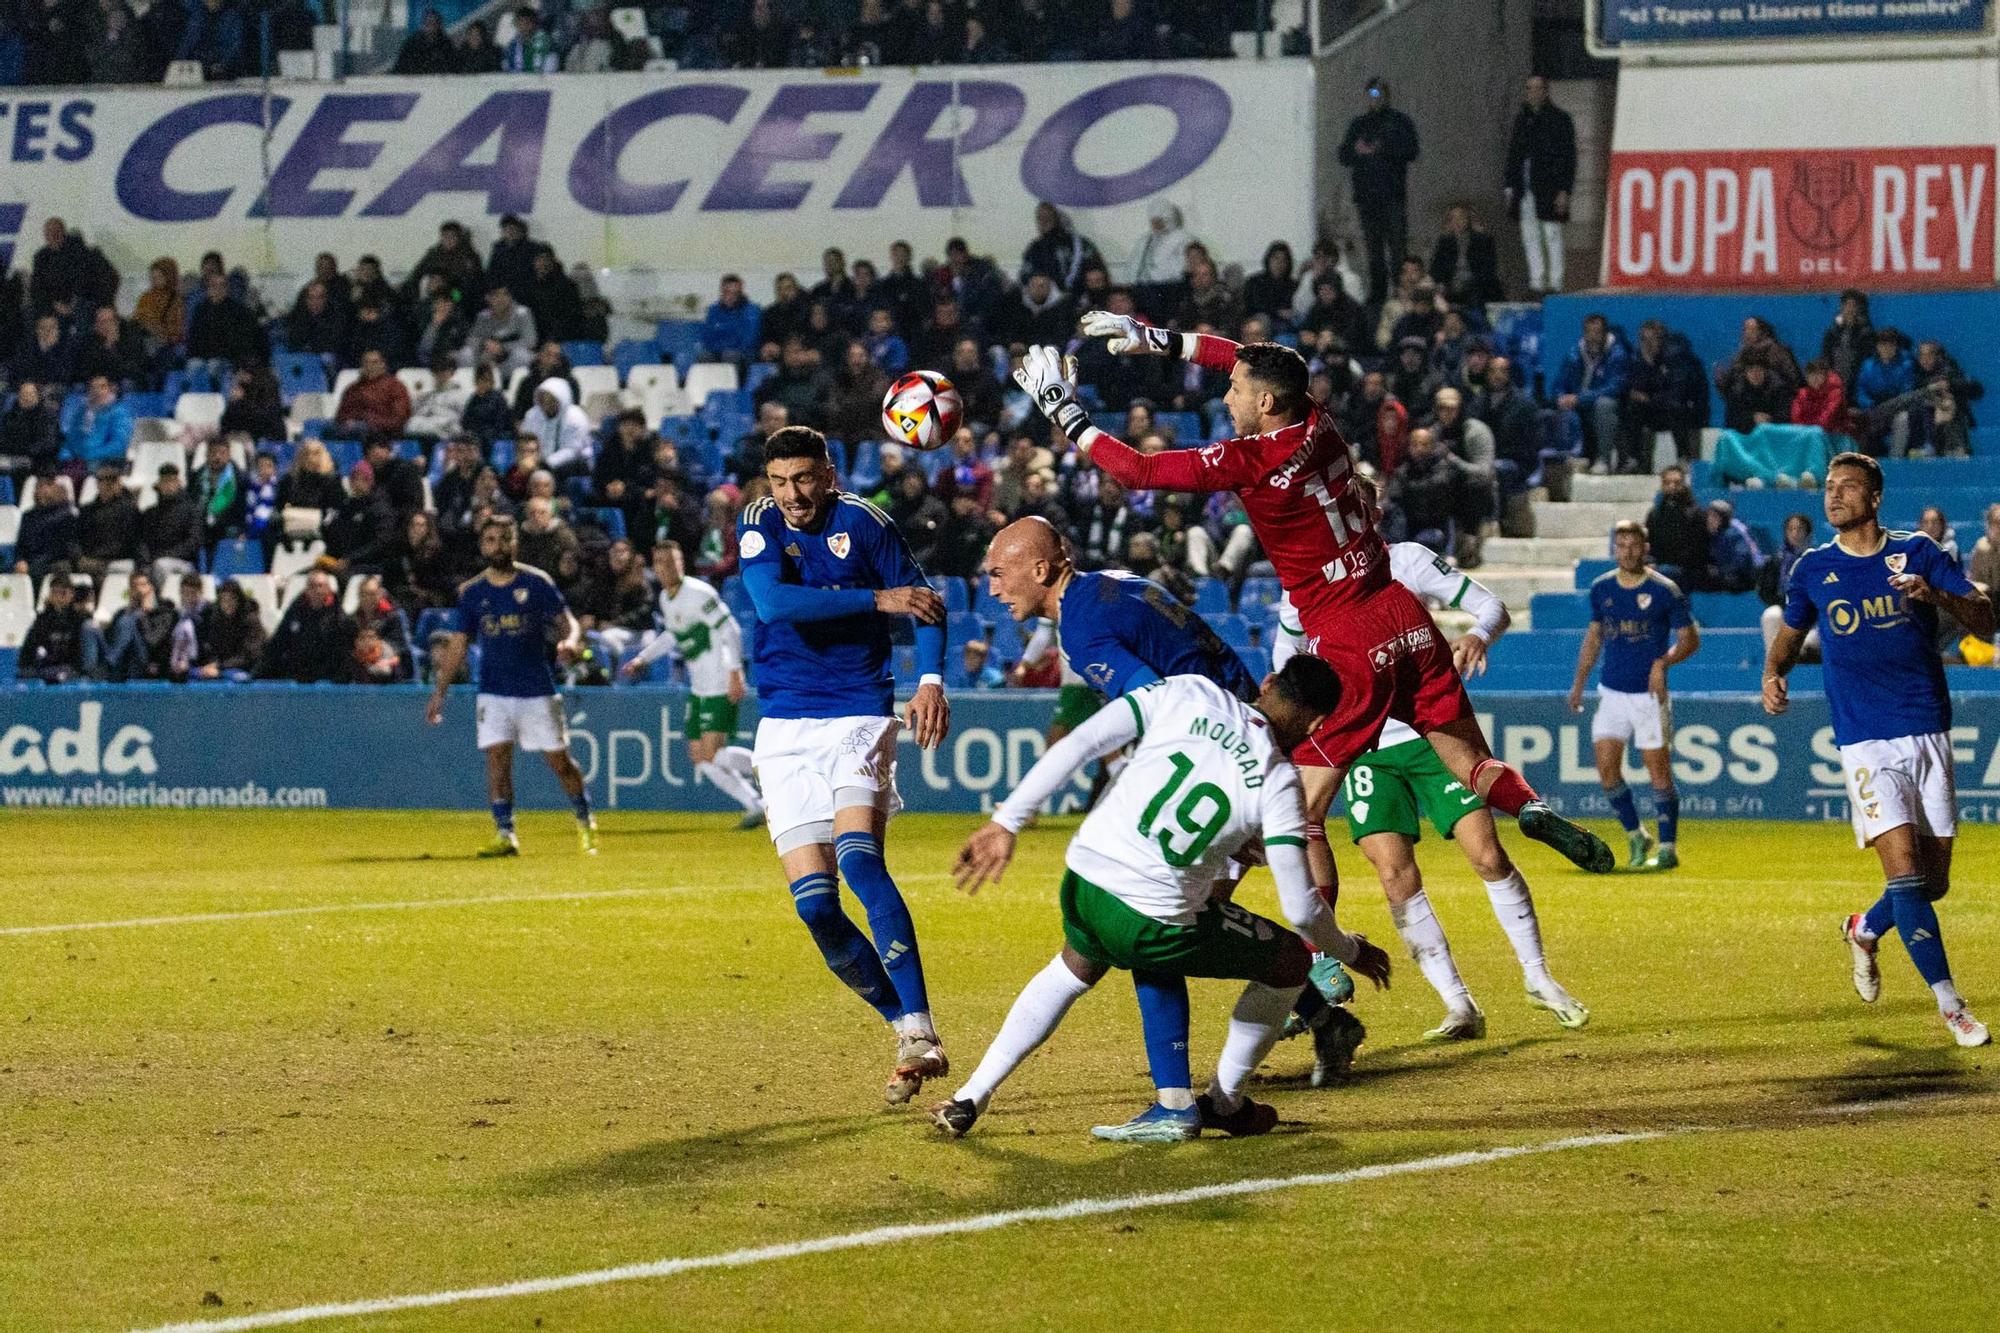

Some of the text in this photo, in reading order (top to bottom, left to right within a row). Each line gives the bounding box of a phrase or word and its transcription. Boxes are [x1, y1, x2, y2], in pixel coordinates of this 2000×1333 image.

[1747, 4, 1822, 21] Linares
[1827, 3, 1878, 18] tiene
[0, 101, 96, 162] ES
[115, 74, 1232, 221] CEACERO
[1618, 164, 1986, 276] COPA REY
[1798, 258, 1847, 275] DEL
[1189, 717, 1265, 789] MOURAD
[1345, 765, 1374, 802] 18
[1137, 751, 1232, 868] 19
[1854, 767, 1874, 801] 2
